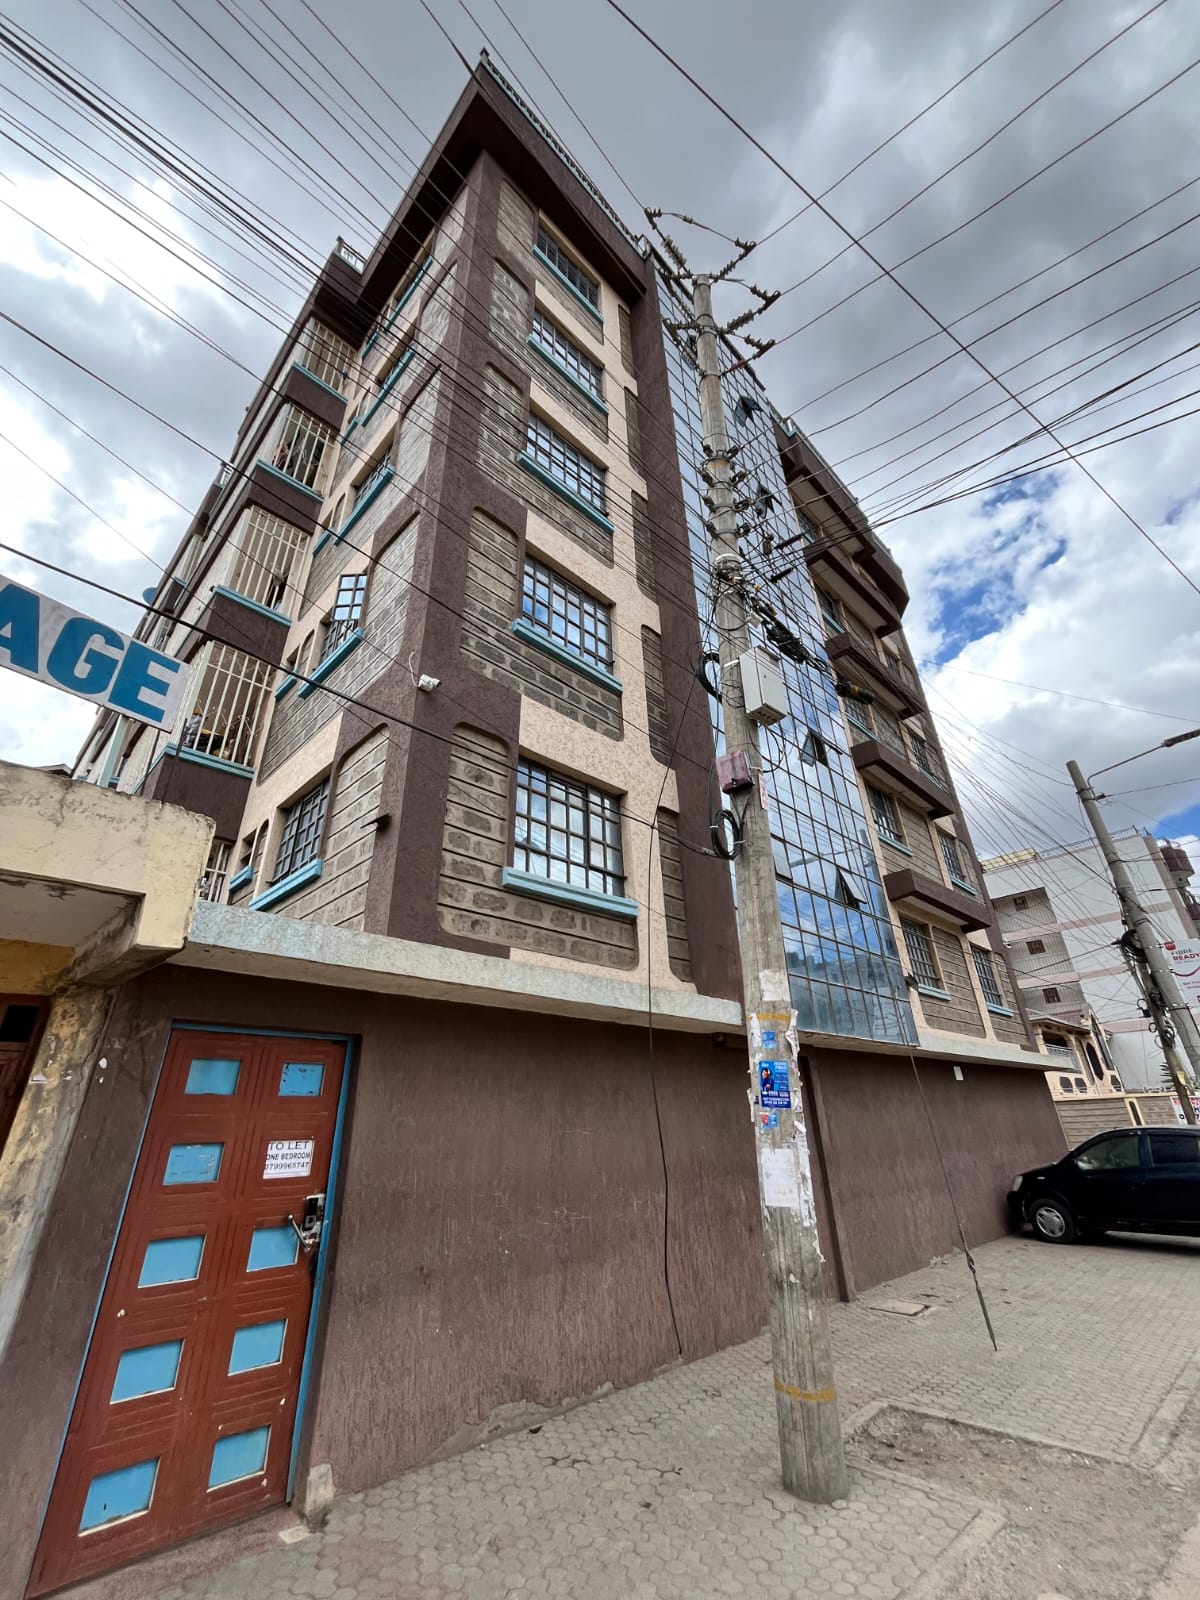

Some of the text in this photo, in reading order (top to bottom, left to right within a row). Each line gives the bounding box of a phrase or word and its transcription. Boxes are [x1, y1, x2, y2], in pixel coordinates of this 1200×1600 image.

[1172, 952, 1200, 961] READY
[270, 1141, 310, 1151] TO LET
[280, 1152, 311, 1160] BEDROOM
